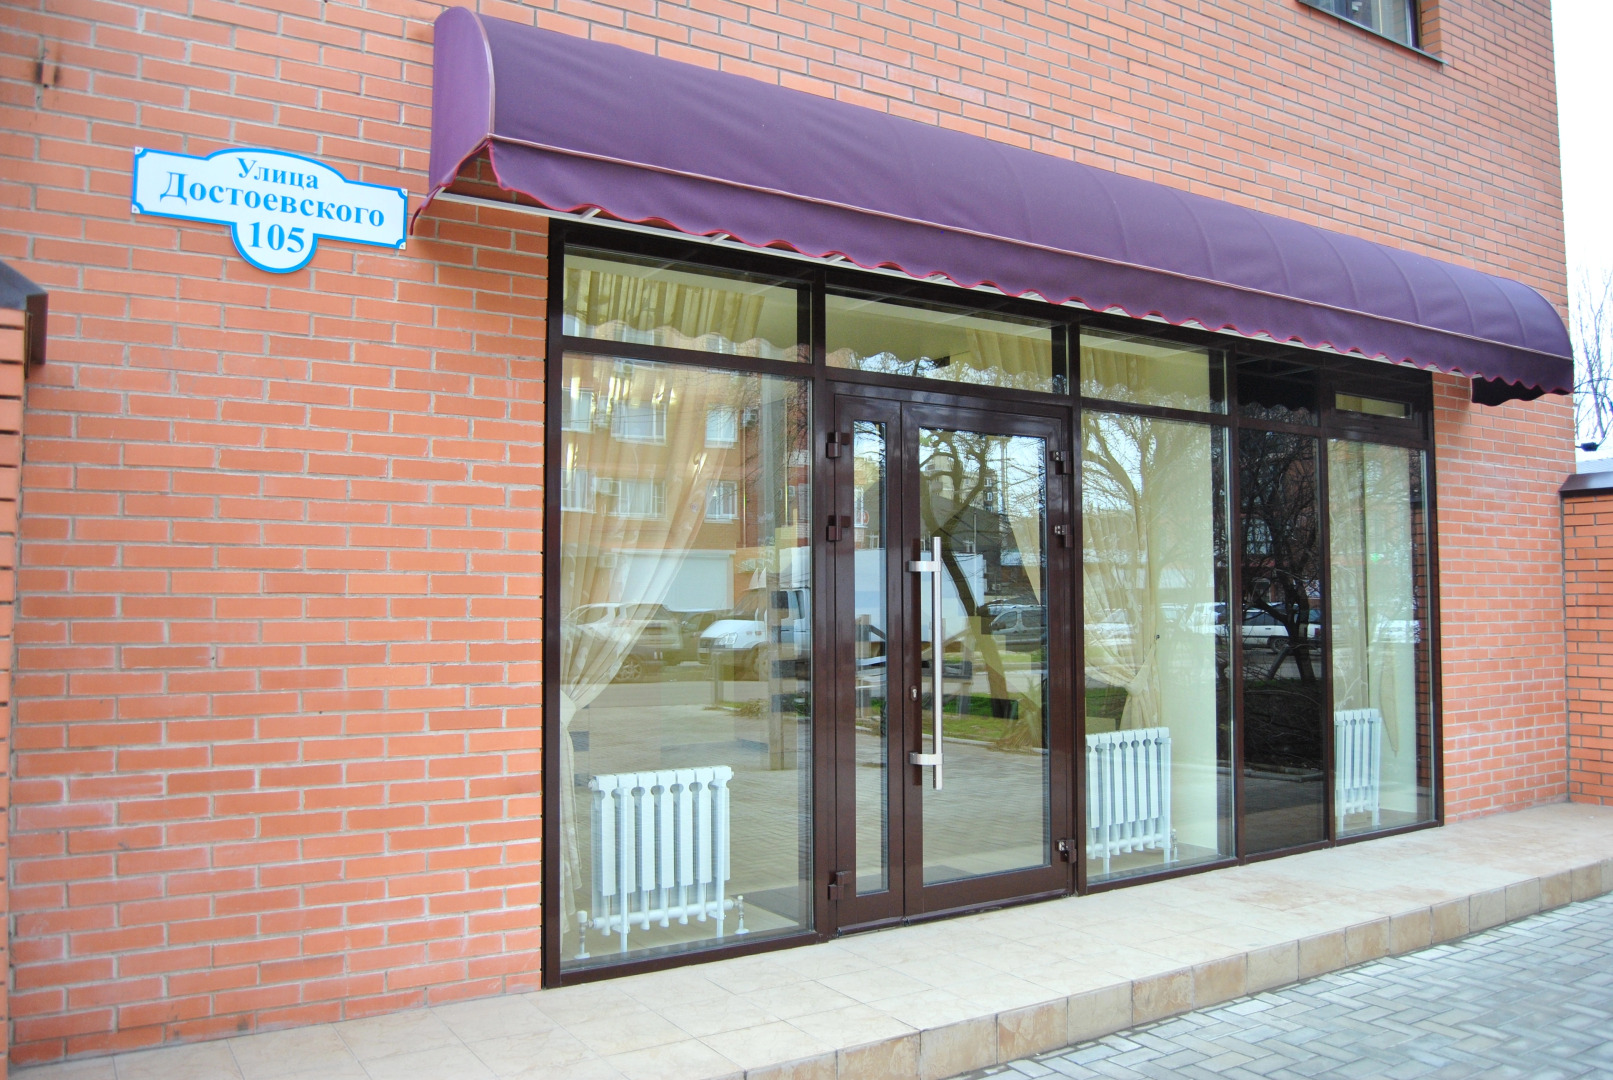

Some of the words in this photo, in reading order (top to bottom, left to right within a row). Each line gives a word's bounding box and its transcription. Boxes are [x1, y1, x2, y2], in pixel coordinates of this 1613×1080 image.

[236, 157, 319, 190] Улица
[160, 171, 385, 227] Достоевского
[248, 222, 305, 253] 105
